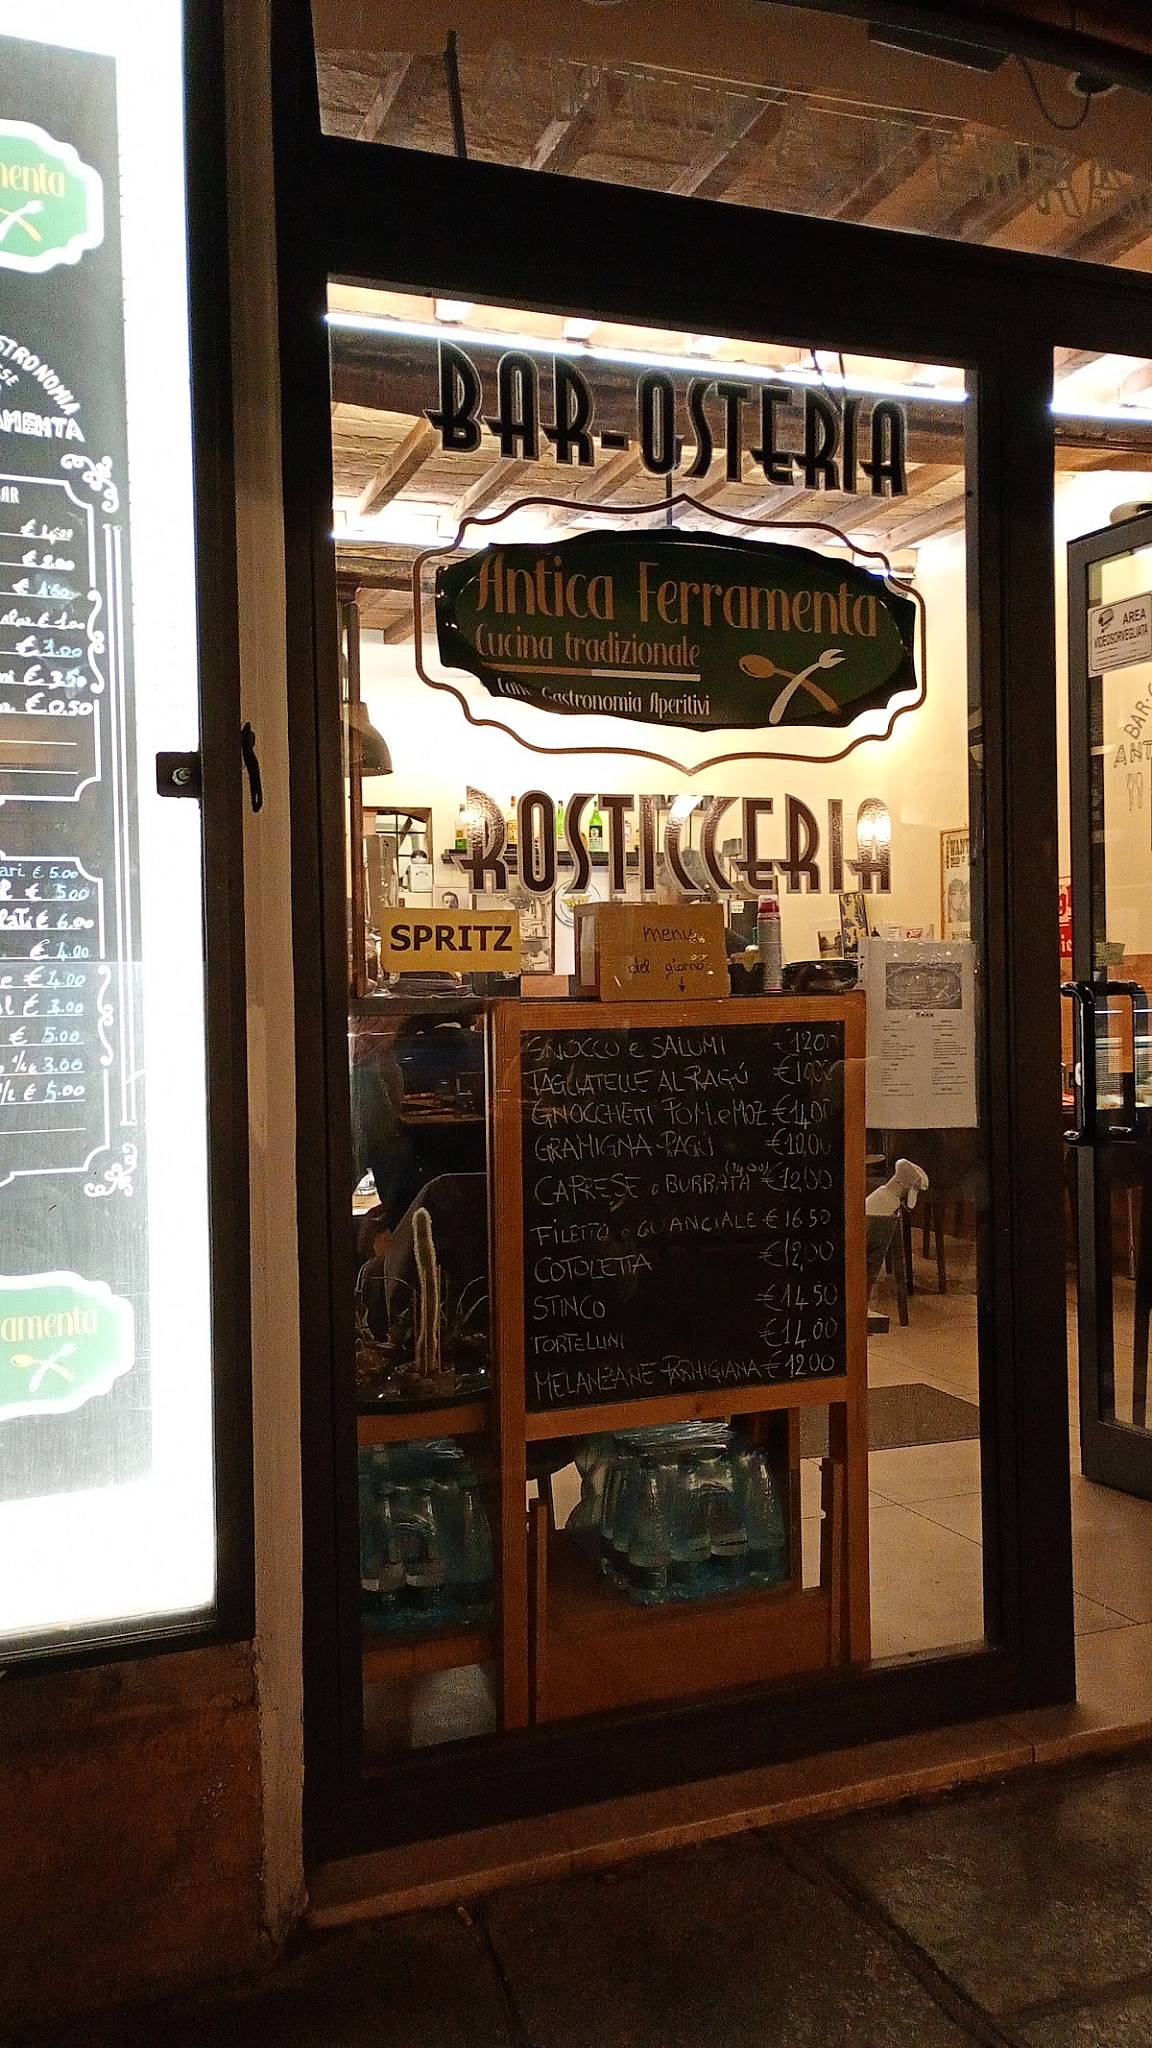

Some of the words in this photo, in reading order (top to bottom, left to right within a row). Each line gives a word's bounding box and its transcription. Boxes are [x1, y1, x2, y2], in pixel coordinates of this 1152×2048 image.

[475, 554, 614, 620] Antica
[635, 561, 879, 637] Ferramenta
[1123, 608, 1147, 625] AREA
[474, 623, 553, 658] Cucina
[565, 631, 701, 667] tradizionale
[650, 691, 710, 719] Aperitivi
[450, 785, 893, 895] ROSTICCERIA
[390, 924, 513, 953] SPRITZ
[628, 957, 650, 974] del
[532, 1294, 607, 1321] STINCO
